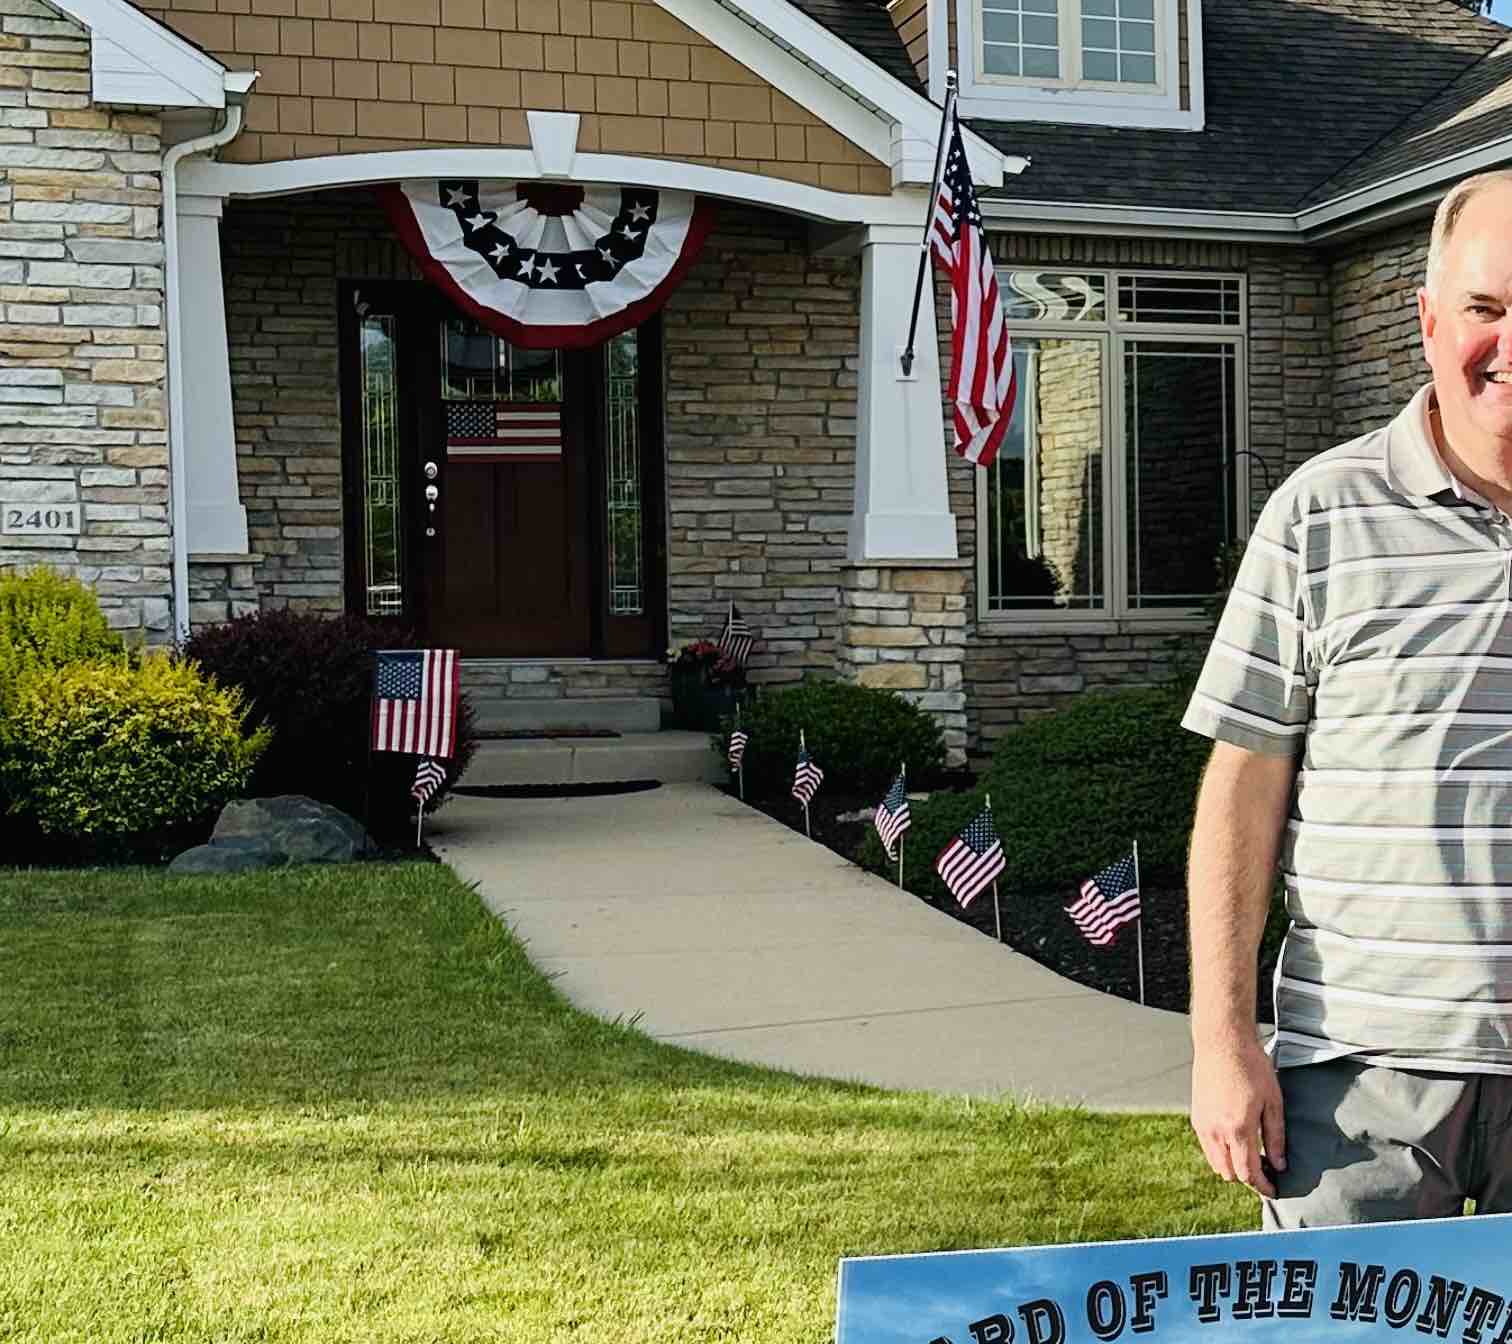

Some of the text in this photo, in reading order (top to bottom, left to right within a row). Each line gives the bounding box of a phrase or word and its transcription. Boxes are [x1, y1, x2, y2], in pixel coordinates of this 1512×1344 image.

[8, 510, 74, 528] 2401
[1086, 1270, 1168, 1341] OF
[1189, 1260, 1317, 1321] THE
